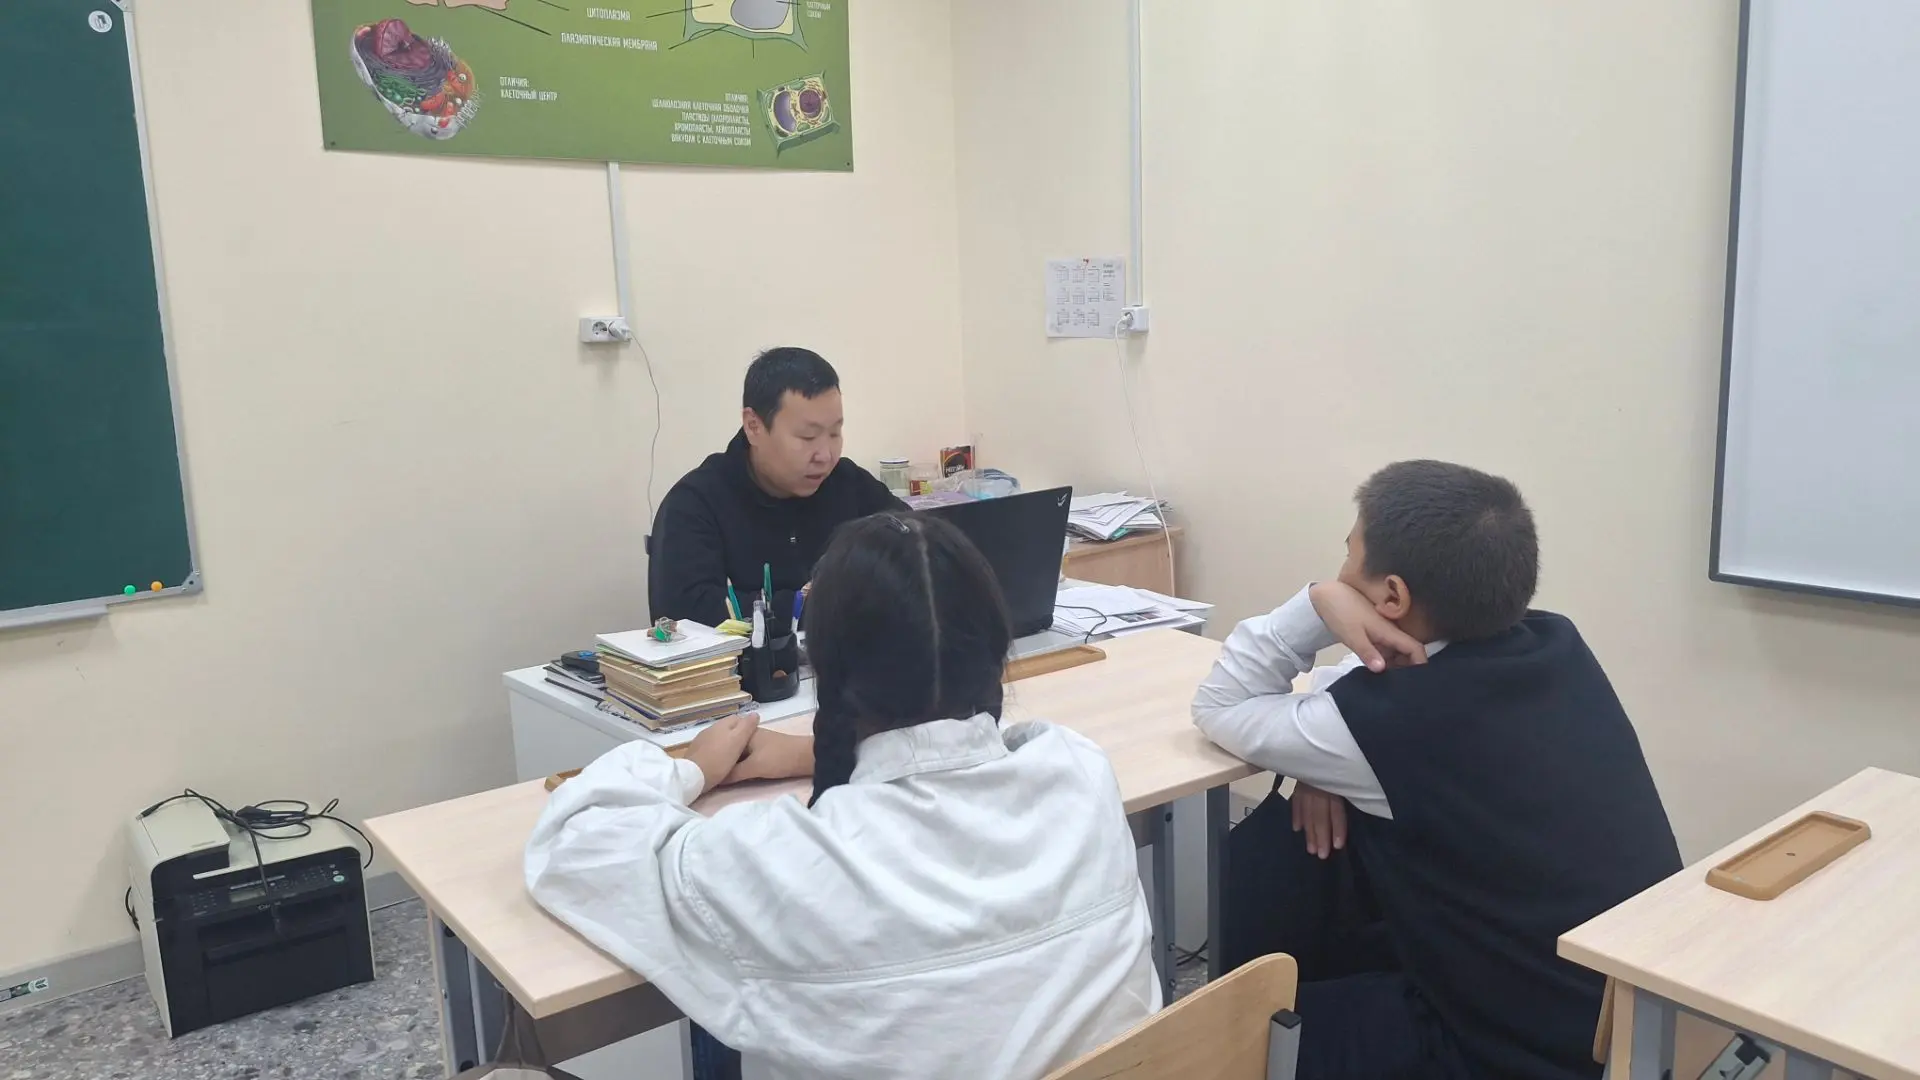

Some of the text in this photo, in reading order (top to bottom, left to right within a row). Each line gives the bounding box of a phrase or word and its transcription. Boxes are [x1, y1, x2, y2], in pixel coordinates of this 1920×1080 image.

[586, 8, 630, 20] ЦИТОПЛАЗМА
[561, 32, 657, 51] ПЛАЗМАТИЧЕСКАЯ МЕМБРАНА
[500, 89, 557, 101] КЛЕТОЧНЫЙ ЦЕНТР
